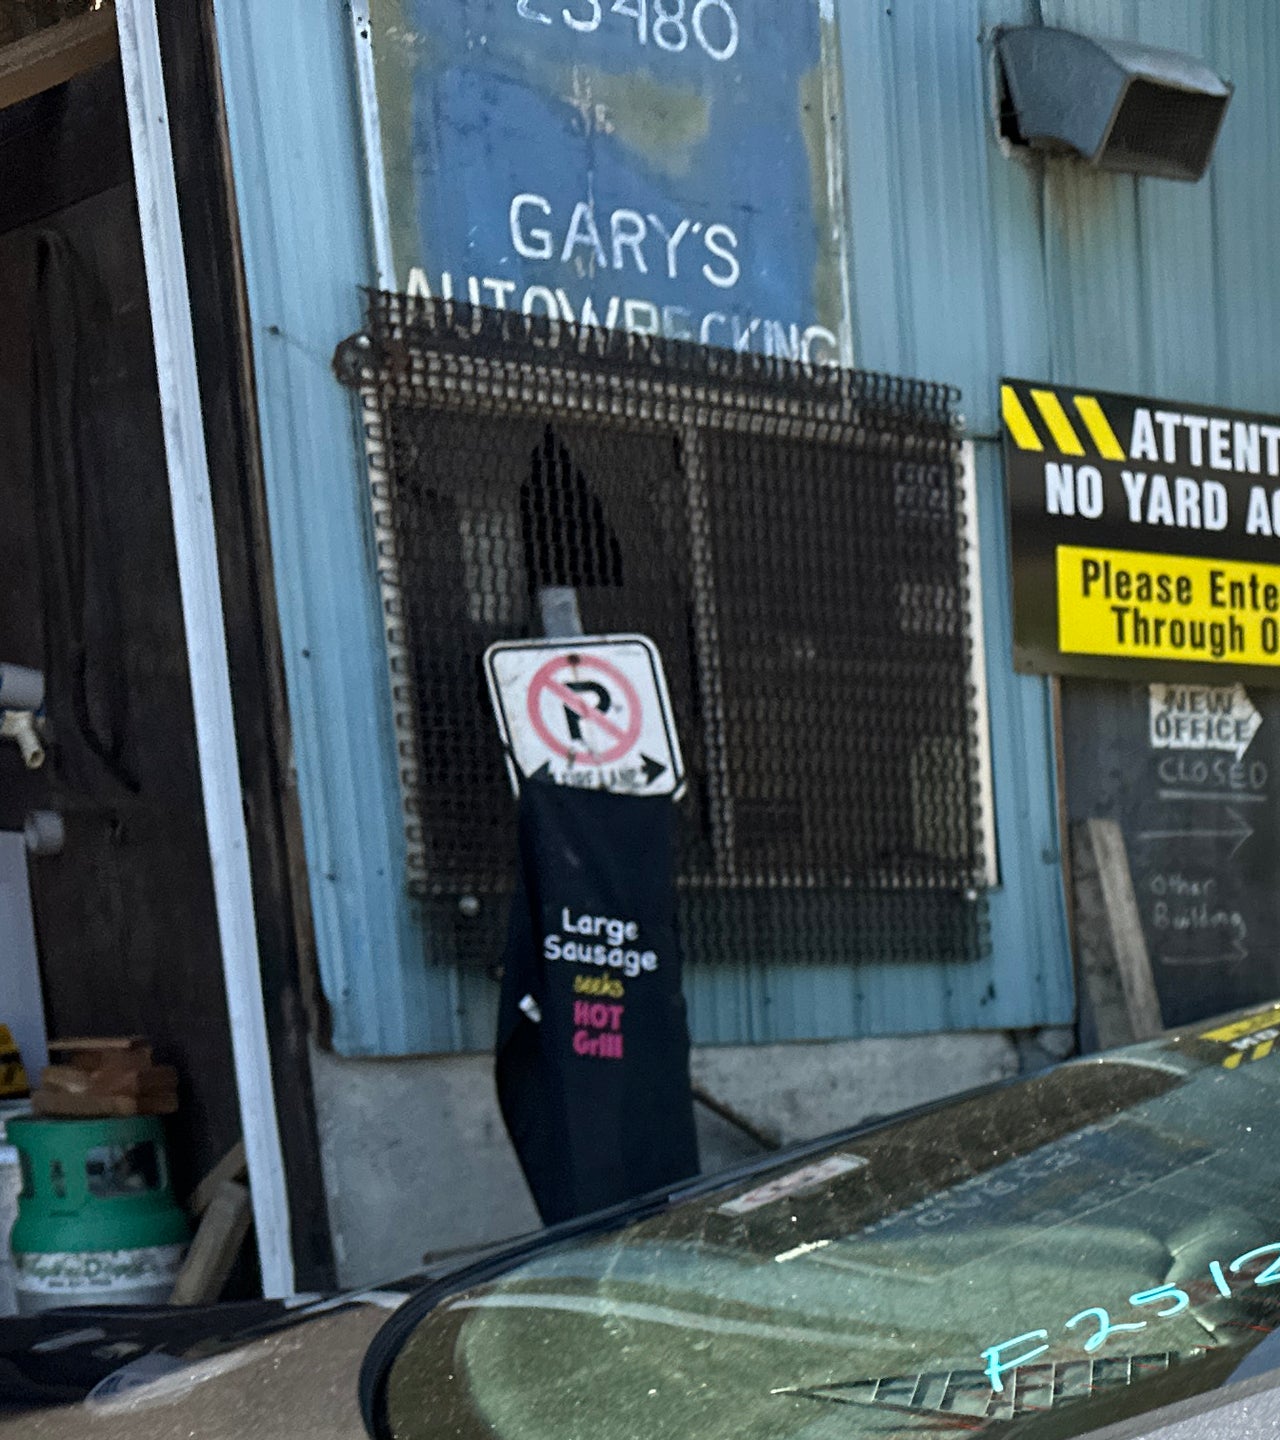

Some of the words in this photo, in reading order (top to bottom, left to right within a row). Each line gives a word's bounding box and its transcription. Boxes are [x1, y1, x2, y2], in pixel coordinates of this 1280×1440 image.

[509, 193, 740, 288] GARY'S
[1044, 462, 1103, 519] NO
[1122, 471, 1228, 531] YARD
[1081, 558, 1193, 605] Please
[1110, 606, 1247, 660] Through
[1154, 711, 1252, 742] OFFICE
[1158, 757, 1268, 789] CLOSED
[562, 906, 640, 947] Large
[543, 934, 659, 978] Sausage
[573, 1000, 625, 1031] HOT
[572, 1030, 624, 1060] Grill
